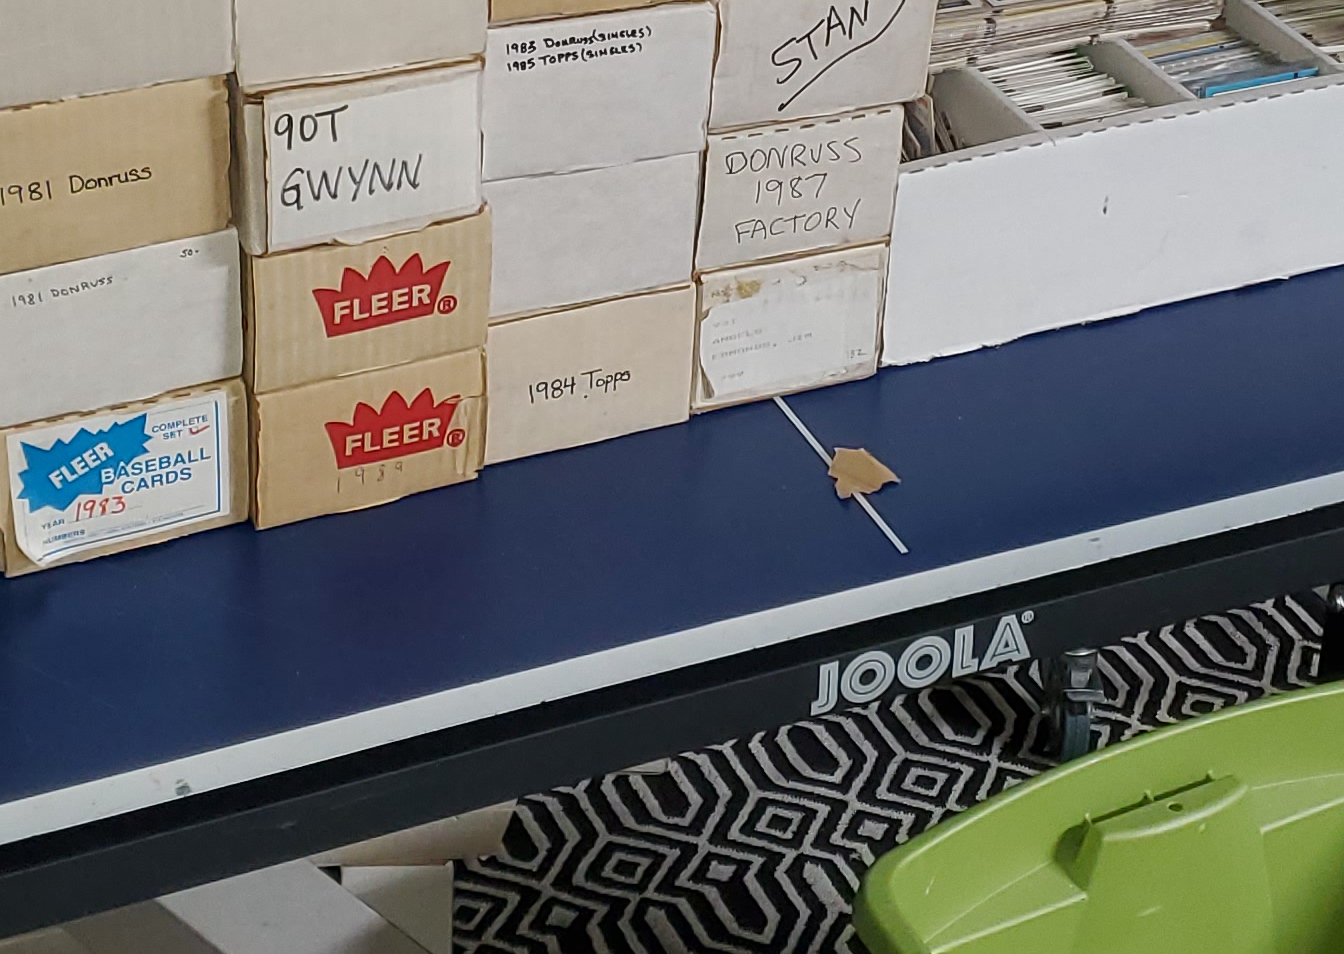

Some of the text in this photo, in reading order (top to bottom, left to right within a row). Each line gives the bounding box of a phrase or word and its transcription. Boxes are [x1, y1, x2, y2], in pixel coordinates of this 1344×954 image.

[274, 104, 349, 150] 90T
[725, 136, 862, 174] DONRUSS
[0, 166, 153, 207] 1981 Donruss
[280, 153, 423, 211] GWYNN
[755, 172, 828, 206] 1987
[734, 198, 862, 244] FACTORY
[11, 276, 114, 308] 1981 DONRUSS
[333, 283, 432, 326] FLEER
[528, 368, 631, 405] 1984 Topps
[151, 414, 208, 434] COMPLETE
[162, 430, 183, 441] SET
[344, 417, 442, 457] FLEER
[47, 442, 115, 490] FLEER
[100, 447, 212, 486] BASEBALL
[120, 467, 193, 495] CARDS
[42, 518, 66, 530] YEAR
[75, 495, 126, 522] 1983
[810, 613, 1032, 717] JOOLA
